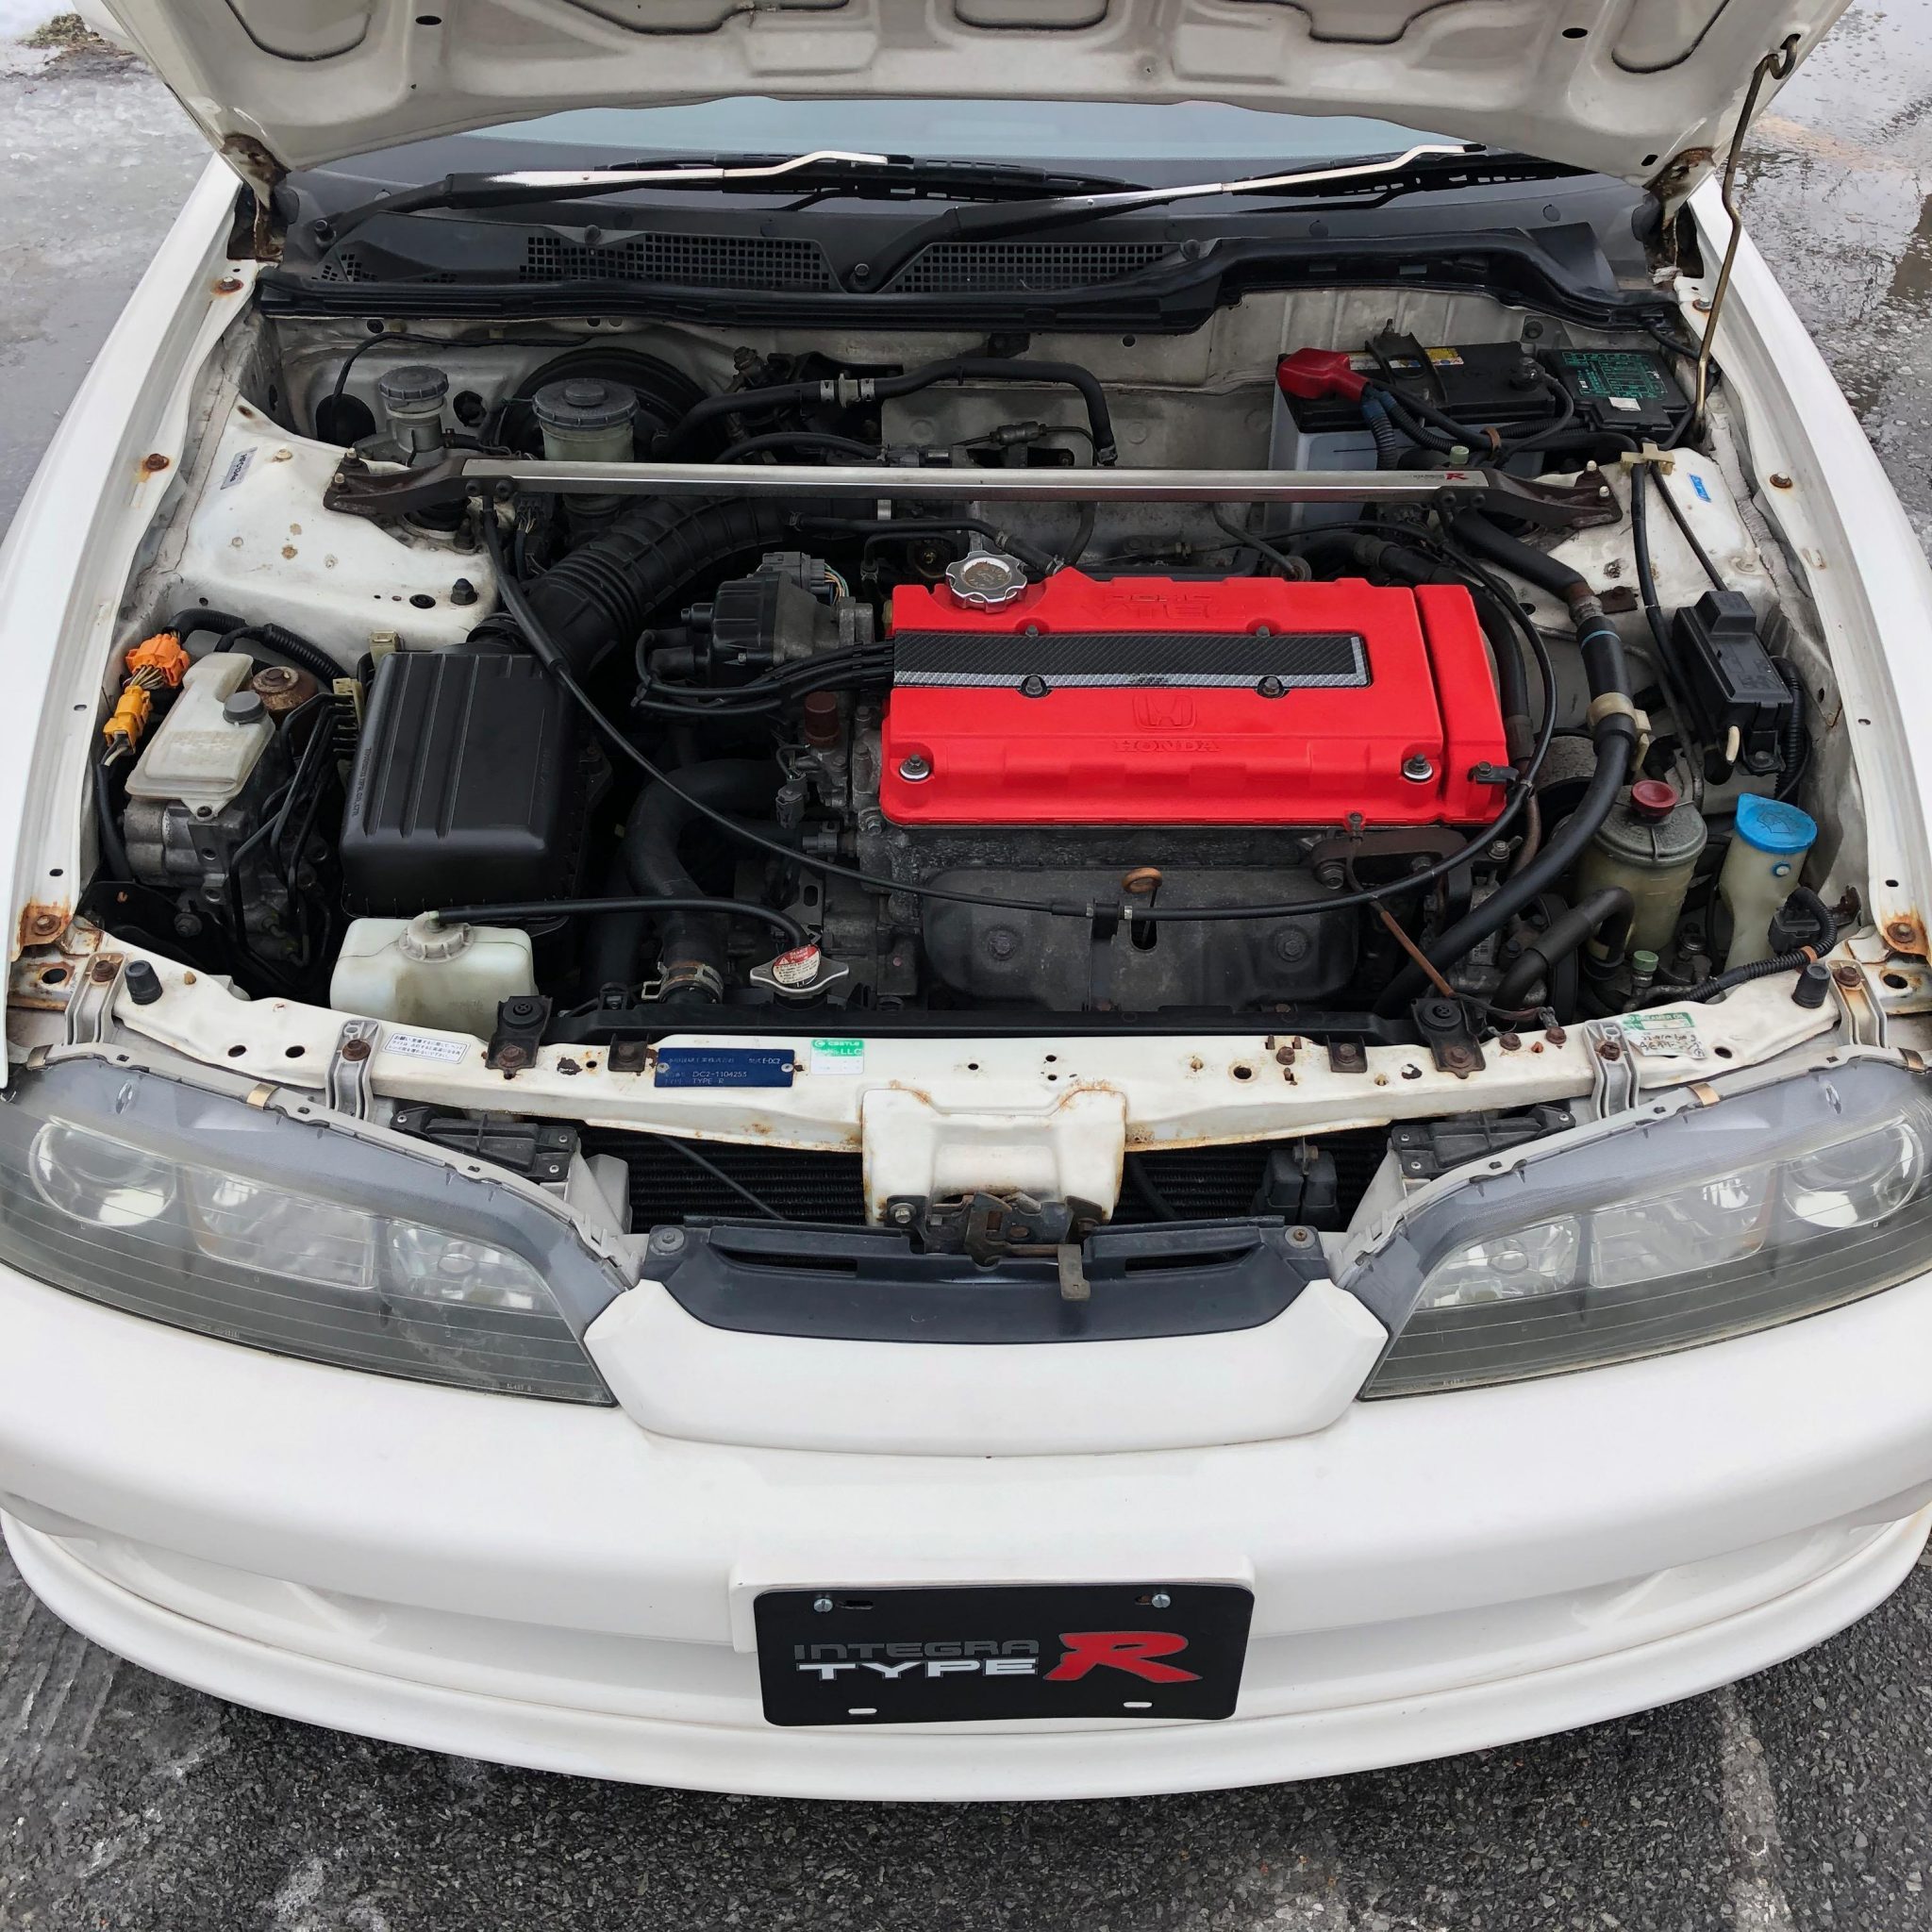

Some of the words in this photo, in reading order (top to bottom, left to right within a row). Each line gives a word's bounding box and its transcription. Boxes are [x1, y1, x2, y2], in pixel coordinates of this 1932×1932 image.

[1115, 740, 1223, 752] HONDA
[793, 1640, 1040, 1661] INTEGRA
[795, 1657, 1039, 1681] TYPE
[1042, 1630, 1204, 1684] R
